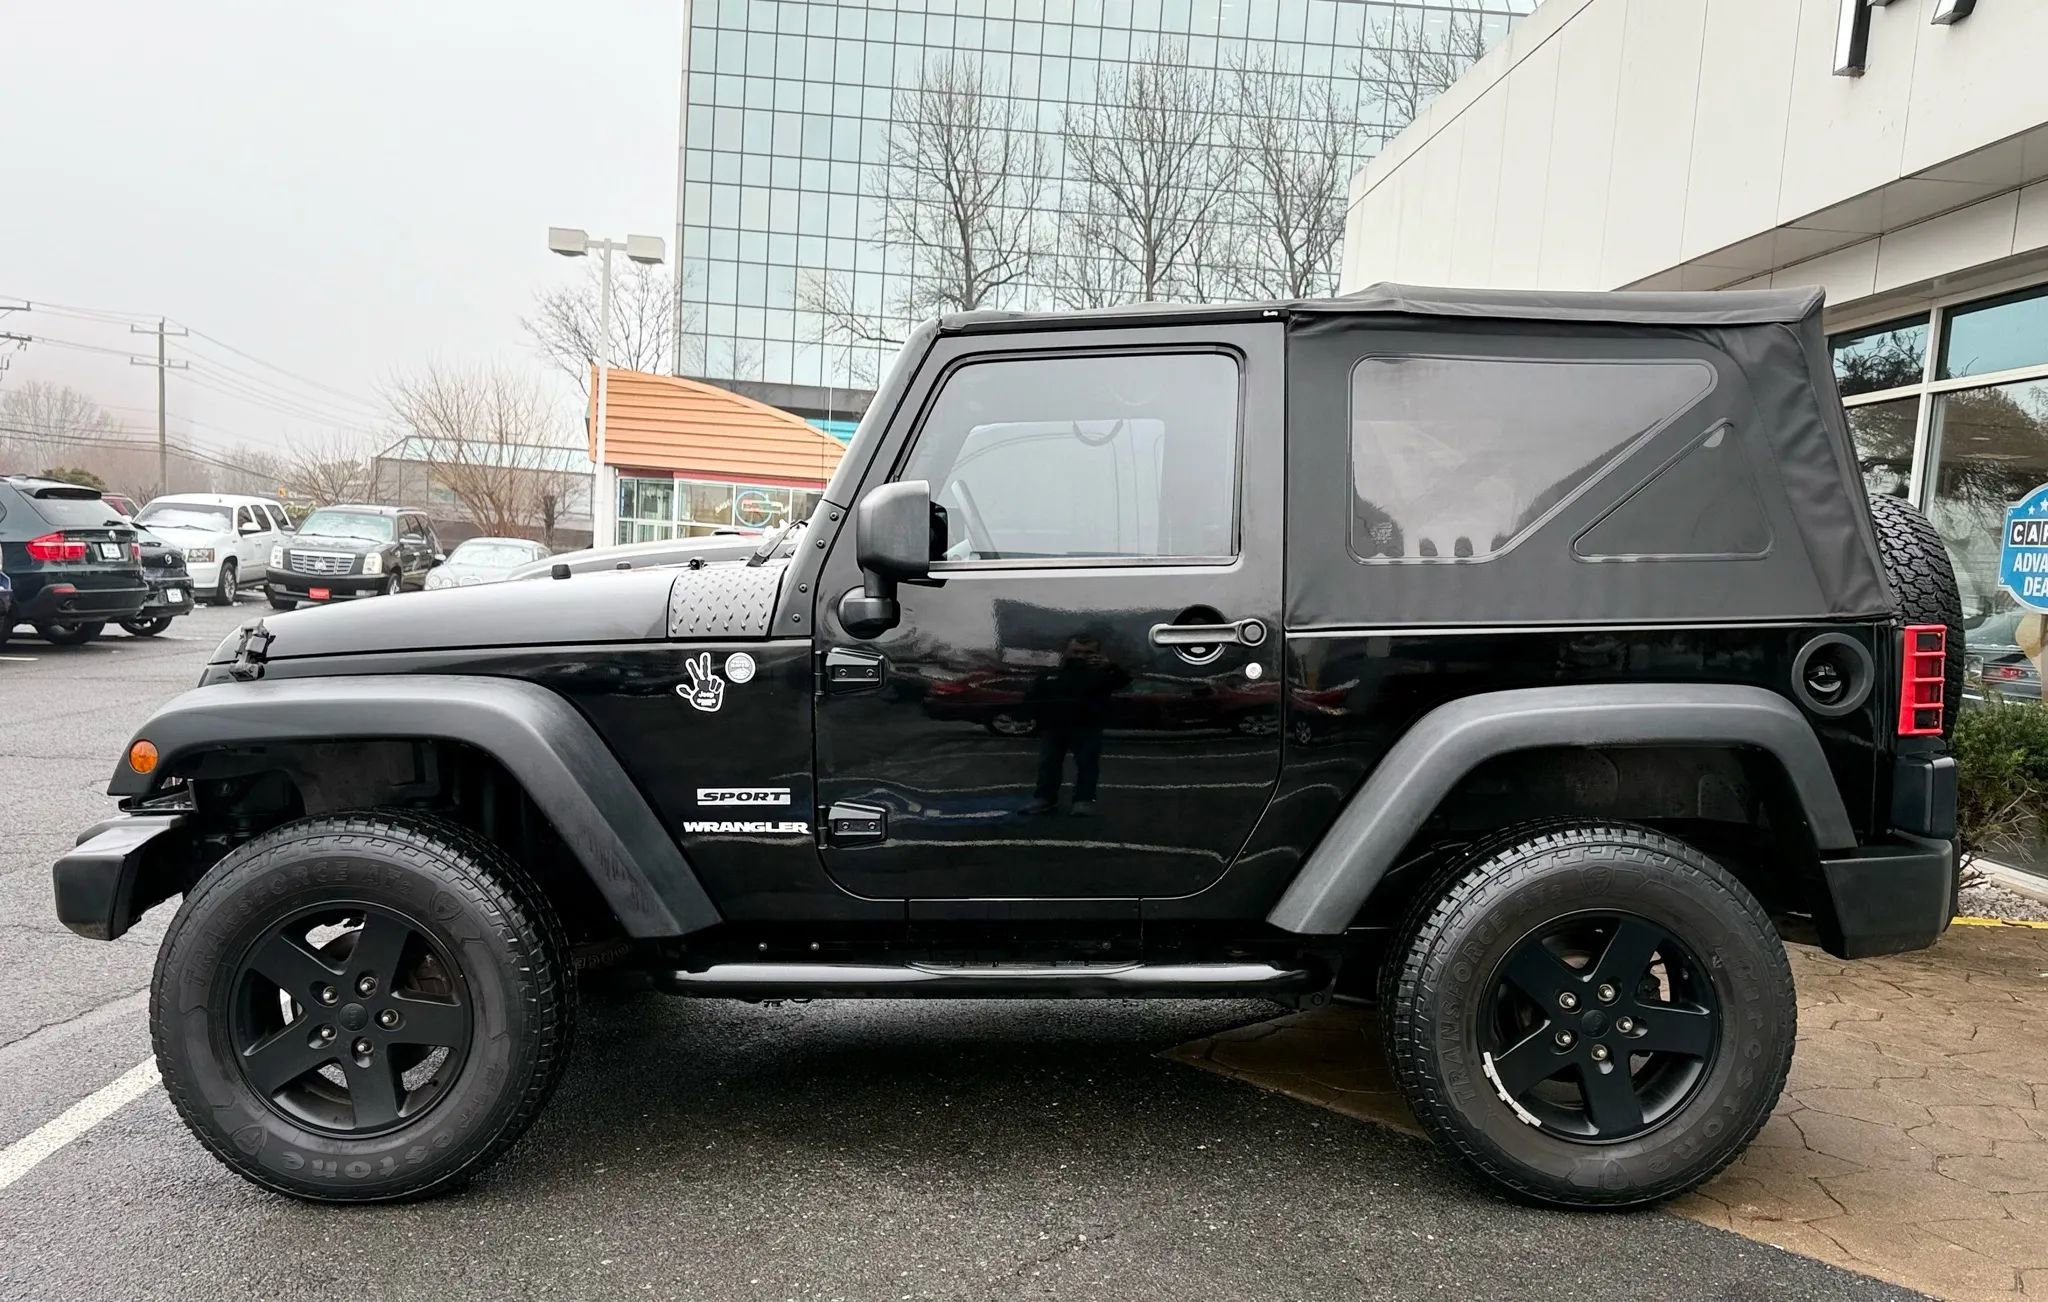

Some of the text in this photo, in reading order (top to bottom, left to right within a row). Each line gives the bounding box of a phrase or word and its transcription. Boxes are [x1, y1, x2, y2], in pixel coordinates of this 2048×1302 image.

[2013, 552, 2048, 573] ADVA
[2023, 576, 2048, 597] DEA
[698, 790, 791, 802] SPORT
[683, 821, 812, 835] WRANGLER
[1440, 911, 1507, 1104] TRANSFORCE
